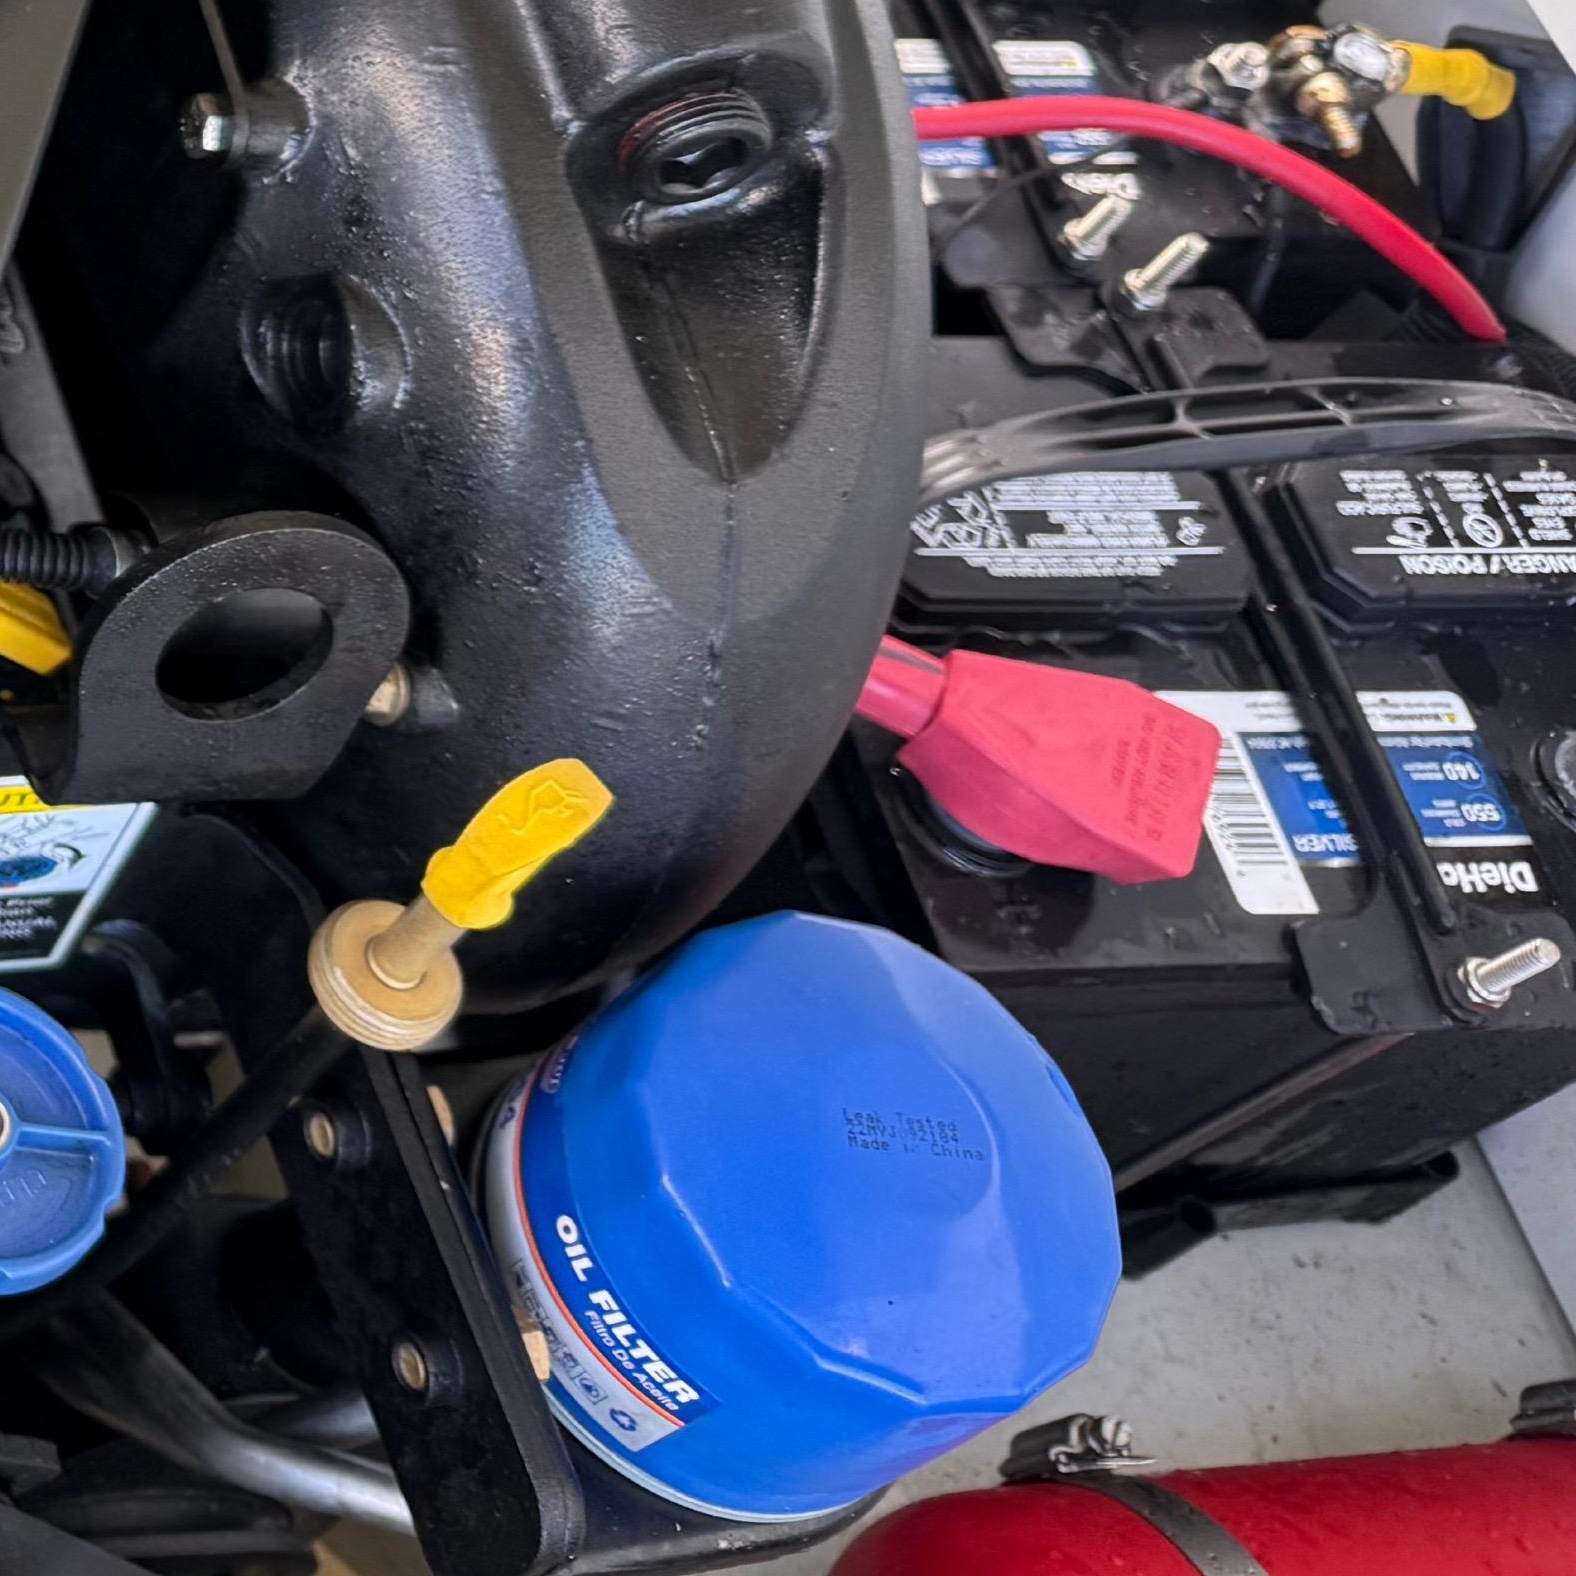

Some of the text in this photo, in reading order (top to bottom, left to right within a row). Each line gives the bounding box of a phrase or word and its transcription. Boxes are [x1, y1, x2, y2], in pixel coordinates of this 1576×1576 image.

[1399, 555, 1487, 574] POISON
[1442, 761, 1481, 781] 140
[1461, 802, 1503, 823] 550
[1293, 832, 1360, 855] SILVER
[847, 1135, 890, 1152] Made
[930, 1143, 986, 1161] China
[556, 1214, 700, 1404] OIL FILTER
[584, 1310, 680, 1412] Filtro De Aceite
